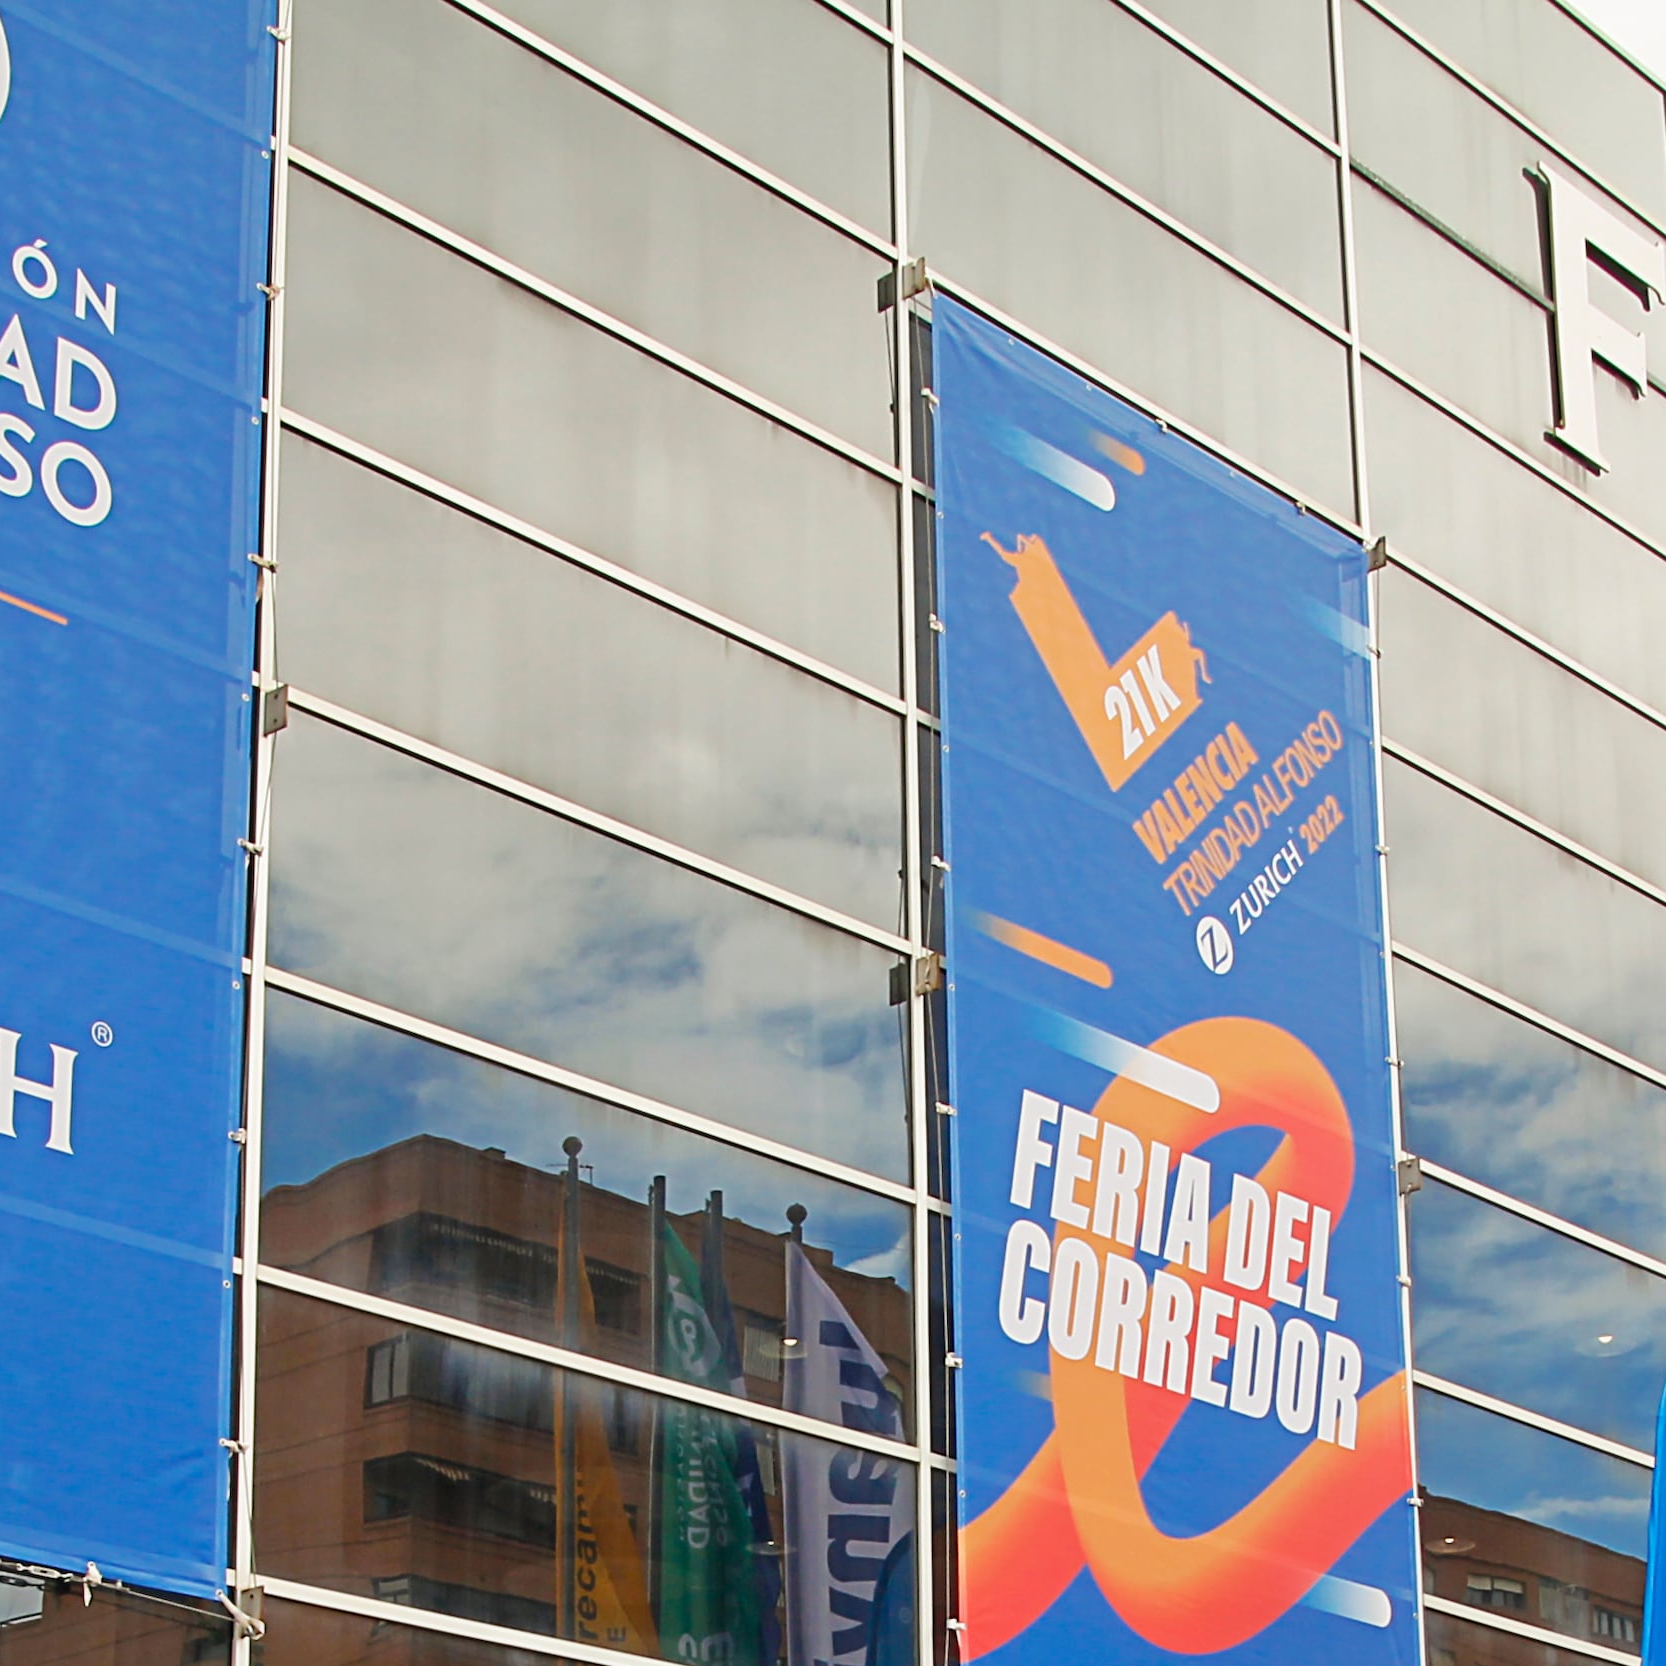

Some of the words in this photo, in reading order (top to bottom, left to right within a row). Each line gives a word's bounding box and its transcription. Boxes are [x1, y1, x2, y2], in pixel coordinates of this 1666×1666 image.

[1104, 643, 1183, 760] 21K
[1132, 721, 1259, 865] VALENCIA
[1162, 800, 1263, 917] TRINIDAD
[1252, 710, 1344, 830] ALFONSO
[1229, 840, 1304, 936] ZURICH
[1299, 795, 1345, 856] 2022
[1010, 1089, 1212, 1276] FERIA
[1223, 1172, 1339, 1322] DEL
[998, 1219, 1364, 1450] CORREDOR
